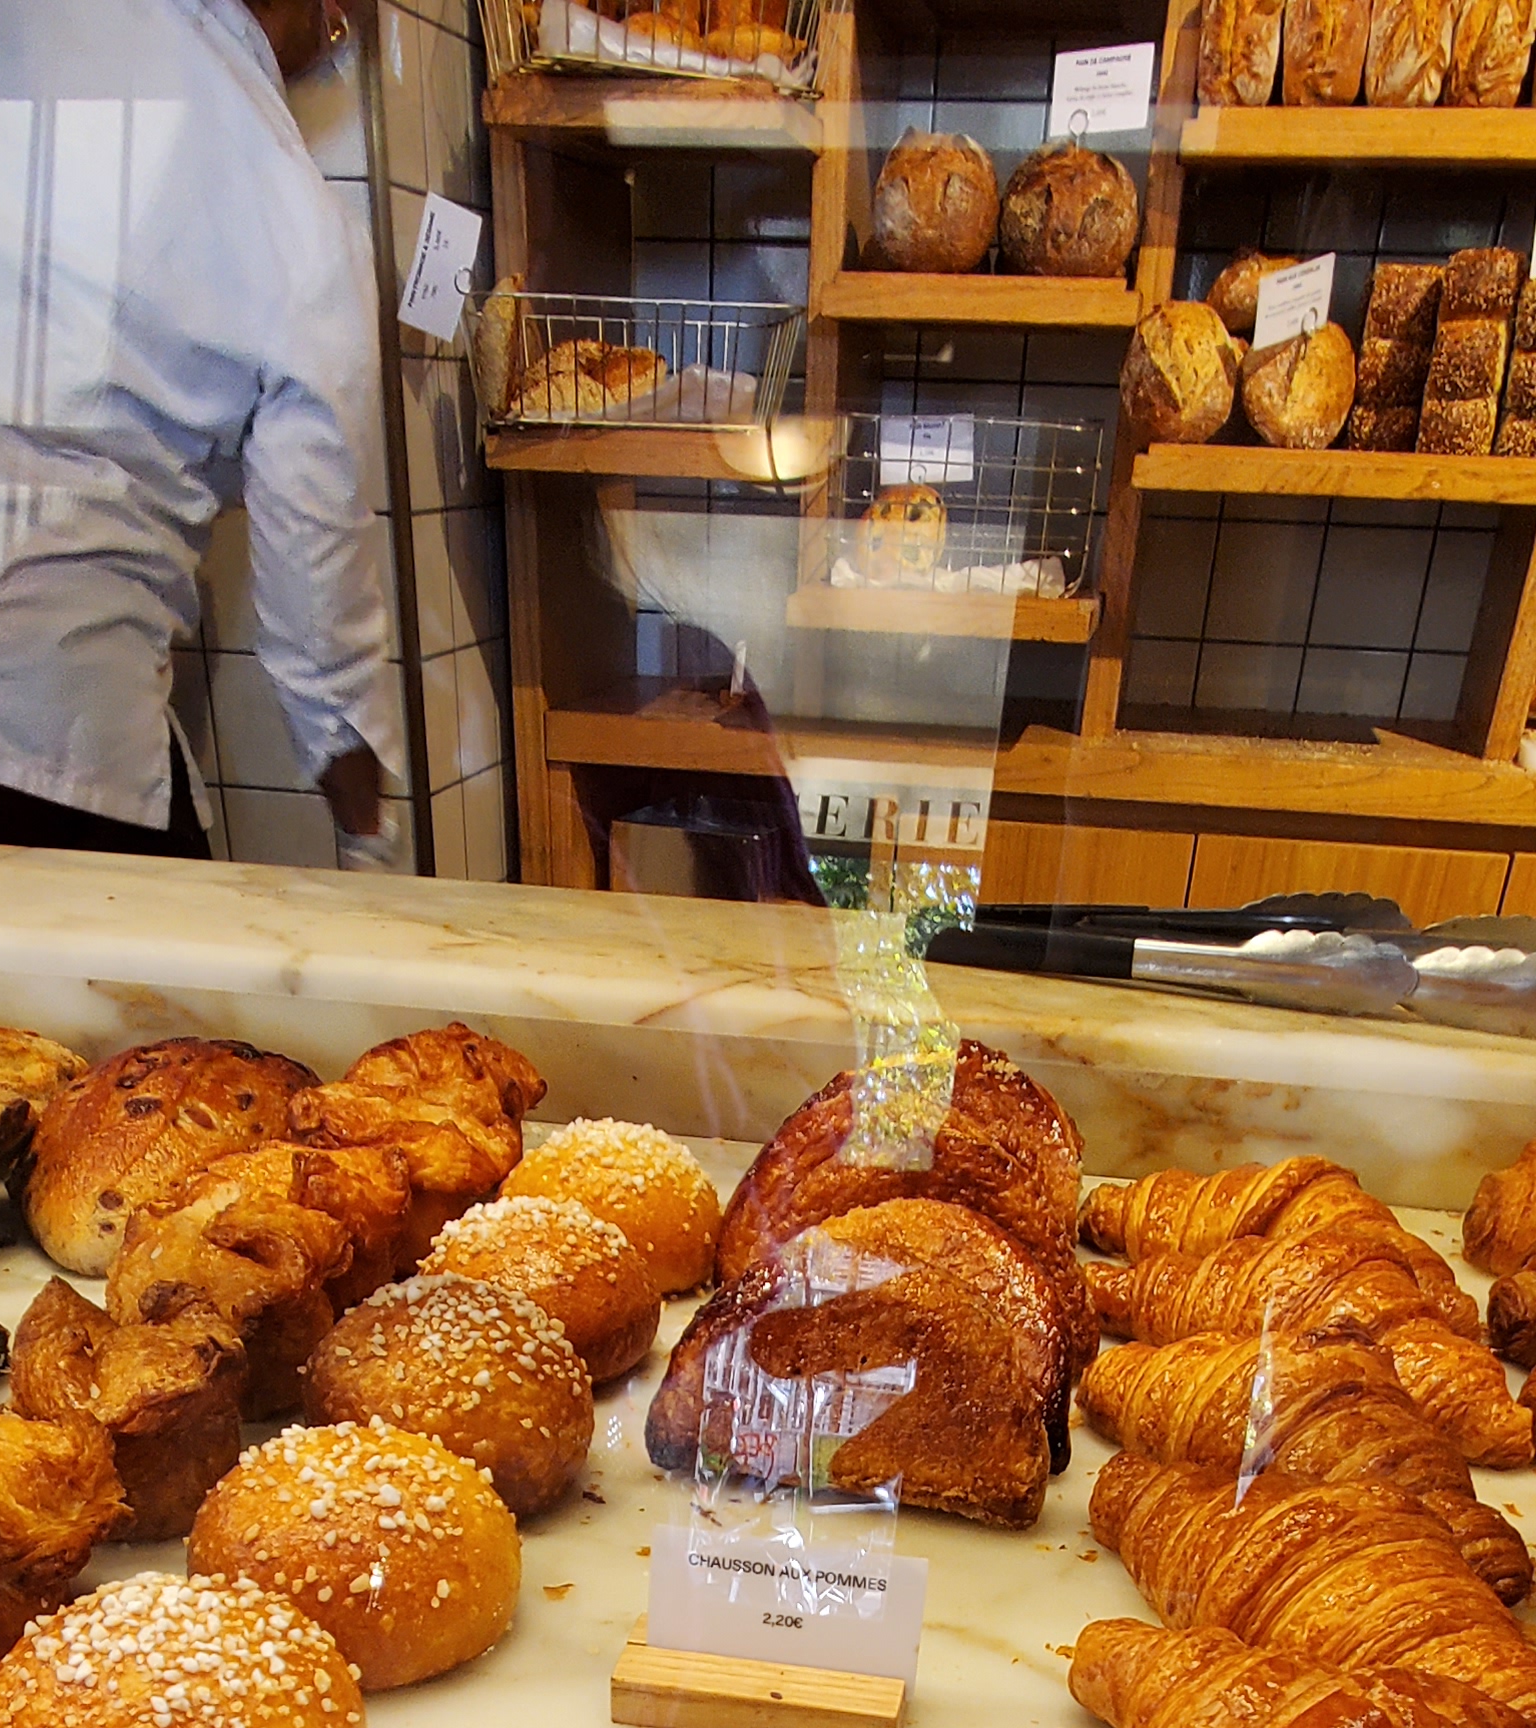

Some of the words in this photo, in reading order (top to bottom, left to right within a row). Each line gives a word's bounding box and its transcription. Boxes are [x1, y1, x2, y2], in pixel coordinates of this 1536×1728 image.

[795, 791, 981, 846] ERIE
[687, 1552, 776, 1578] CHAUSSON
[814, 1570, 888, 1592] POMMES
[761, 1611, 804, 1630] 2,20€
